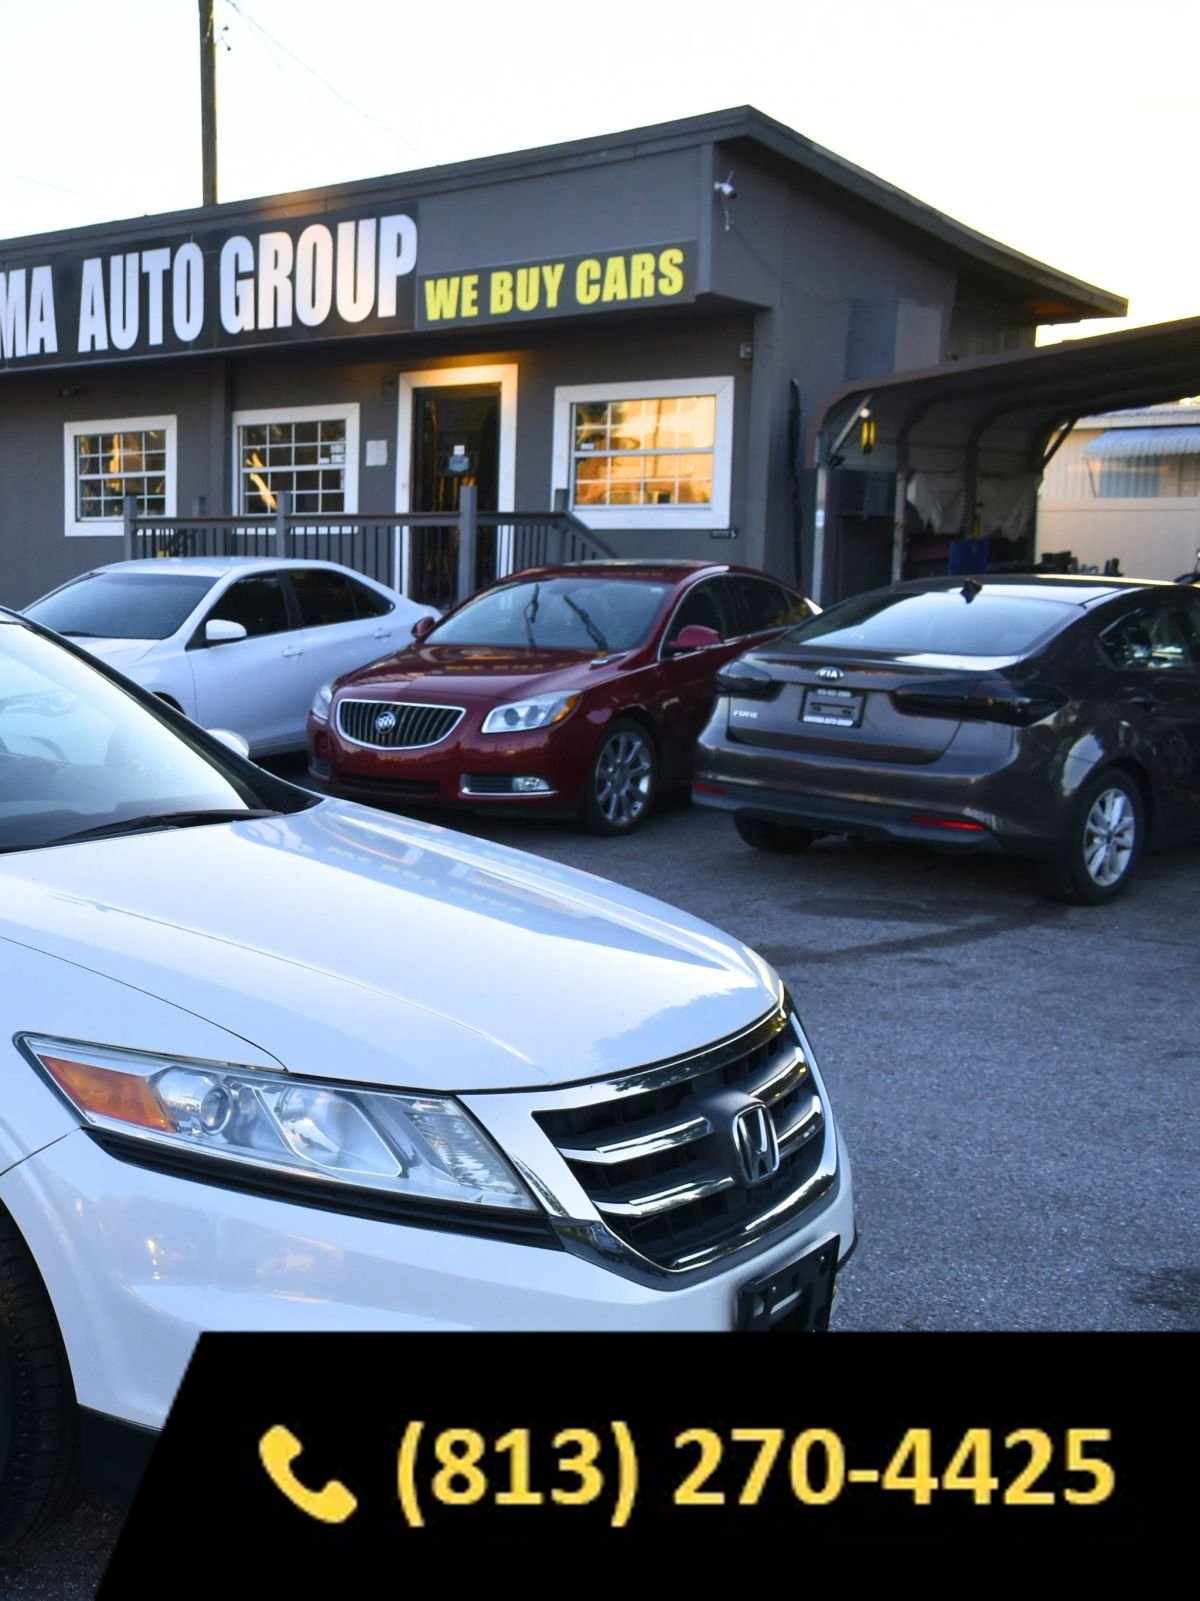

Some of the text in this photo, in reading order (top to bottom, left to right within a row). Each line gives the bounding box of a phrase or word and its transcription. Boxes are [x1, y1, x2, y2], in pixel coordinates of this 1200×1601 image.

[78, 242, 204, 352] AUTO
[220, 214, 418, 335] GROUP
[425, 248, 684, 321] WE BUY CARS
